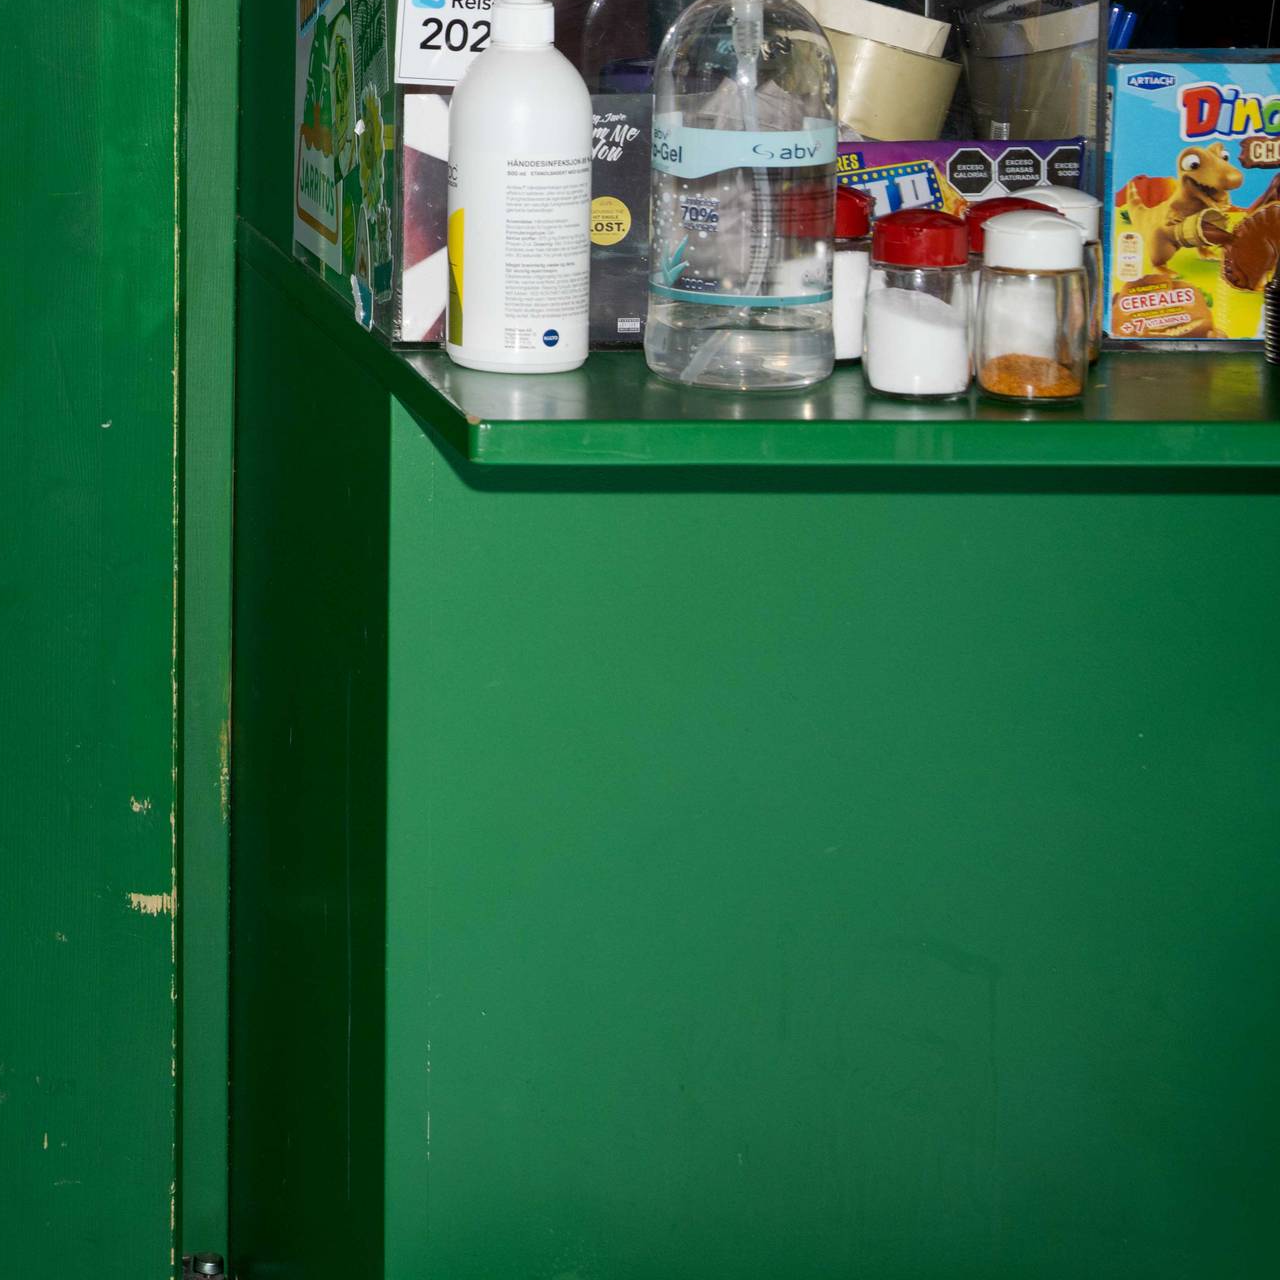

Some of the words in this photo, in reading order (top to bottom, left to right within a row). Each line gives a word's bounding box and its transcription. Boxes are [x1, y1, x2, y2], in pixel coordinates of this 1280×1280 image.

[1128, 76, 1175, 88] ARTIACH
[1004, 158, 1034, 166] EXCESO
[956, 164, 985, 172] EXCESO
[1005, 166, 1034, 174] GRASAS
[999, 173, 1040, 182] SATURADAS
[679, 206, 720, 223] 70%
[1121, 289, 1194, 311] CEREALES
